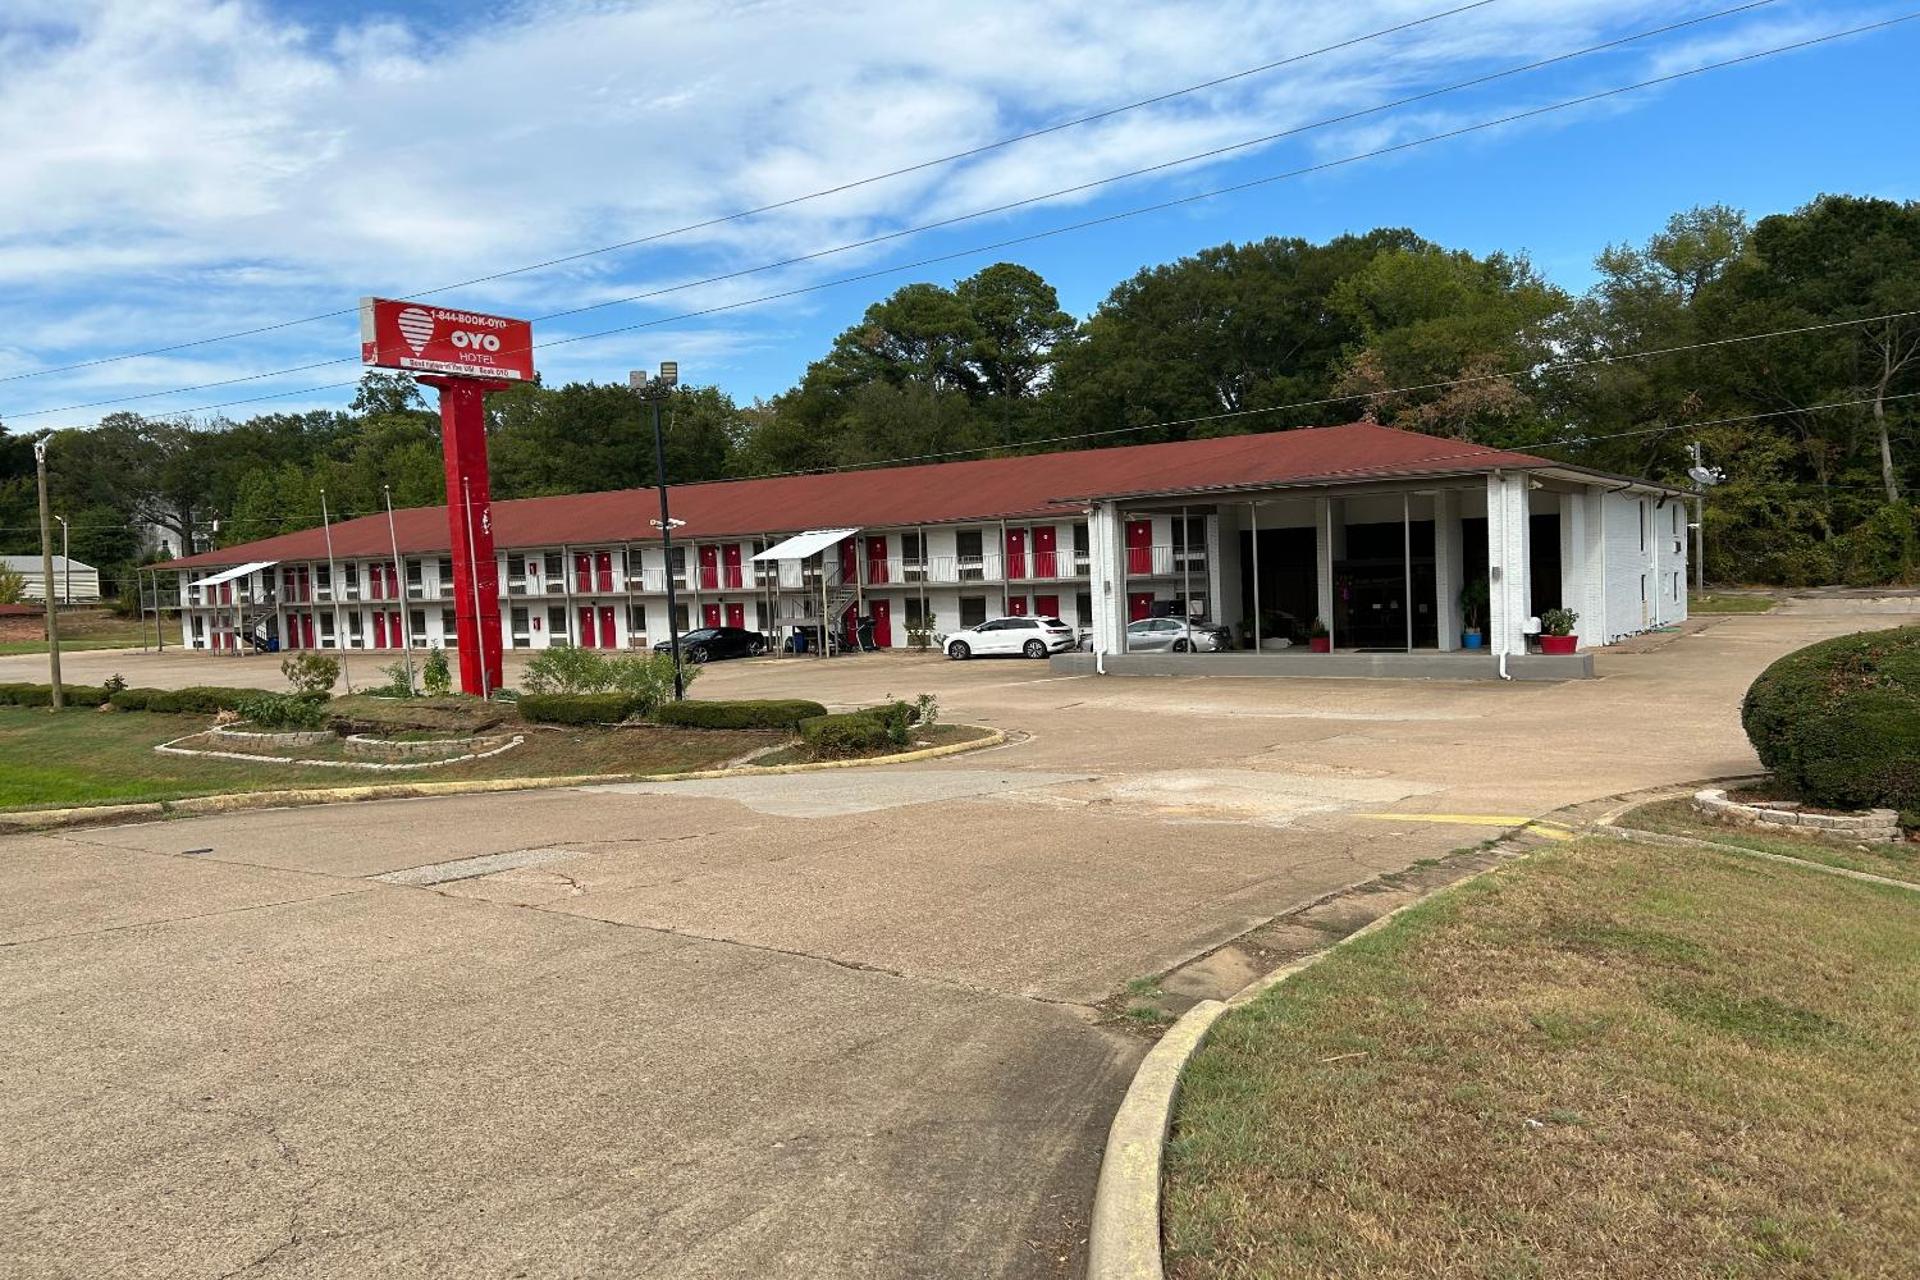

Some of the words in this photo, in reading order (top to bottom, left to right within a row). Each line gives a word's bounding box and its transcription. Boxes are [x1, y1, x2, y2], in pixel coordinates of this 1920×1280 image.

[430, 310, 507, 329] 1-844-BOOK-OYO
[451, 330, 500, 352] OYO
[459, 351, 496, 364] HOTEL
